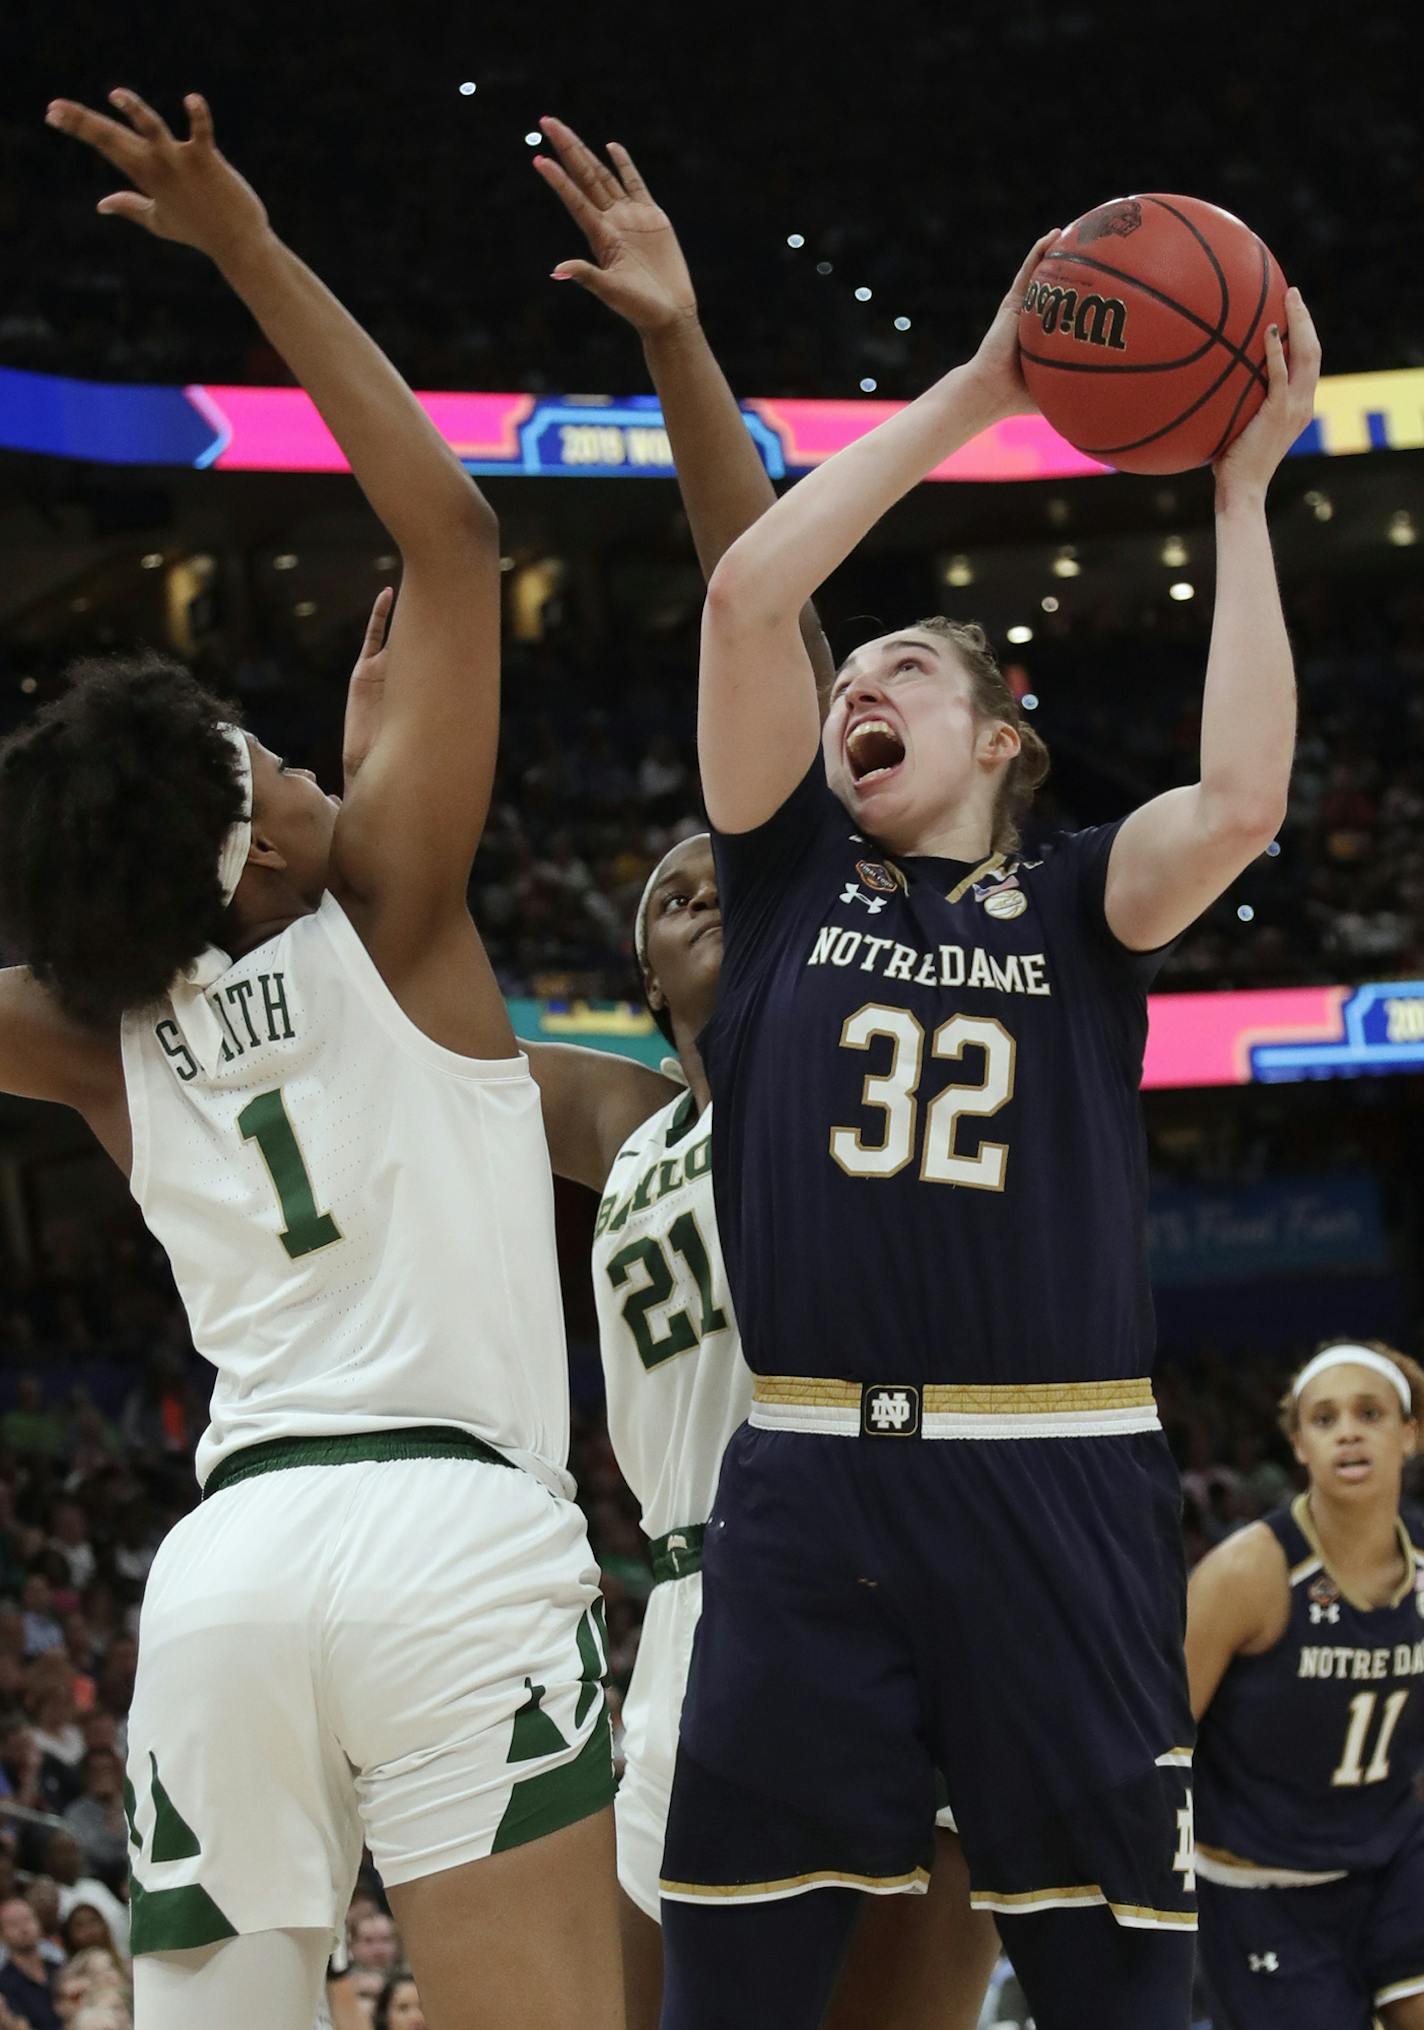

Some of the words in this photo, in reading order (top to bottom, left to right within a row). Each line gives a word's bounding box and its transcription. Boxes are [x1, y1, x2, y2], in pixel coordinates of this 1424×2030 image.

[807, 926, 937, 986] NOTRE
[938, 945, 1051, 996] DAME
[155, 972, 296, 1082] SITH
[829, 1001, 1016, 1192] 32
[235, 1086, 346, 1260] 1
[605, 1207, 730, 1374] 21
[1298, 1645, 1390, 1680] NOTRE
[1331, 1689, 1410, 1787] 11
